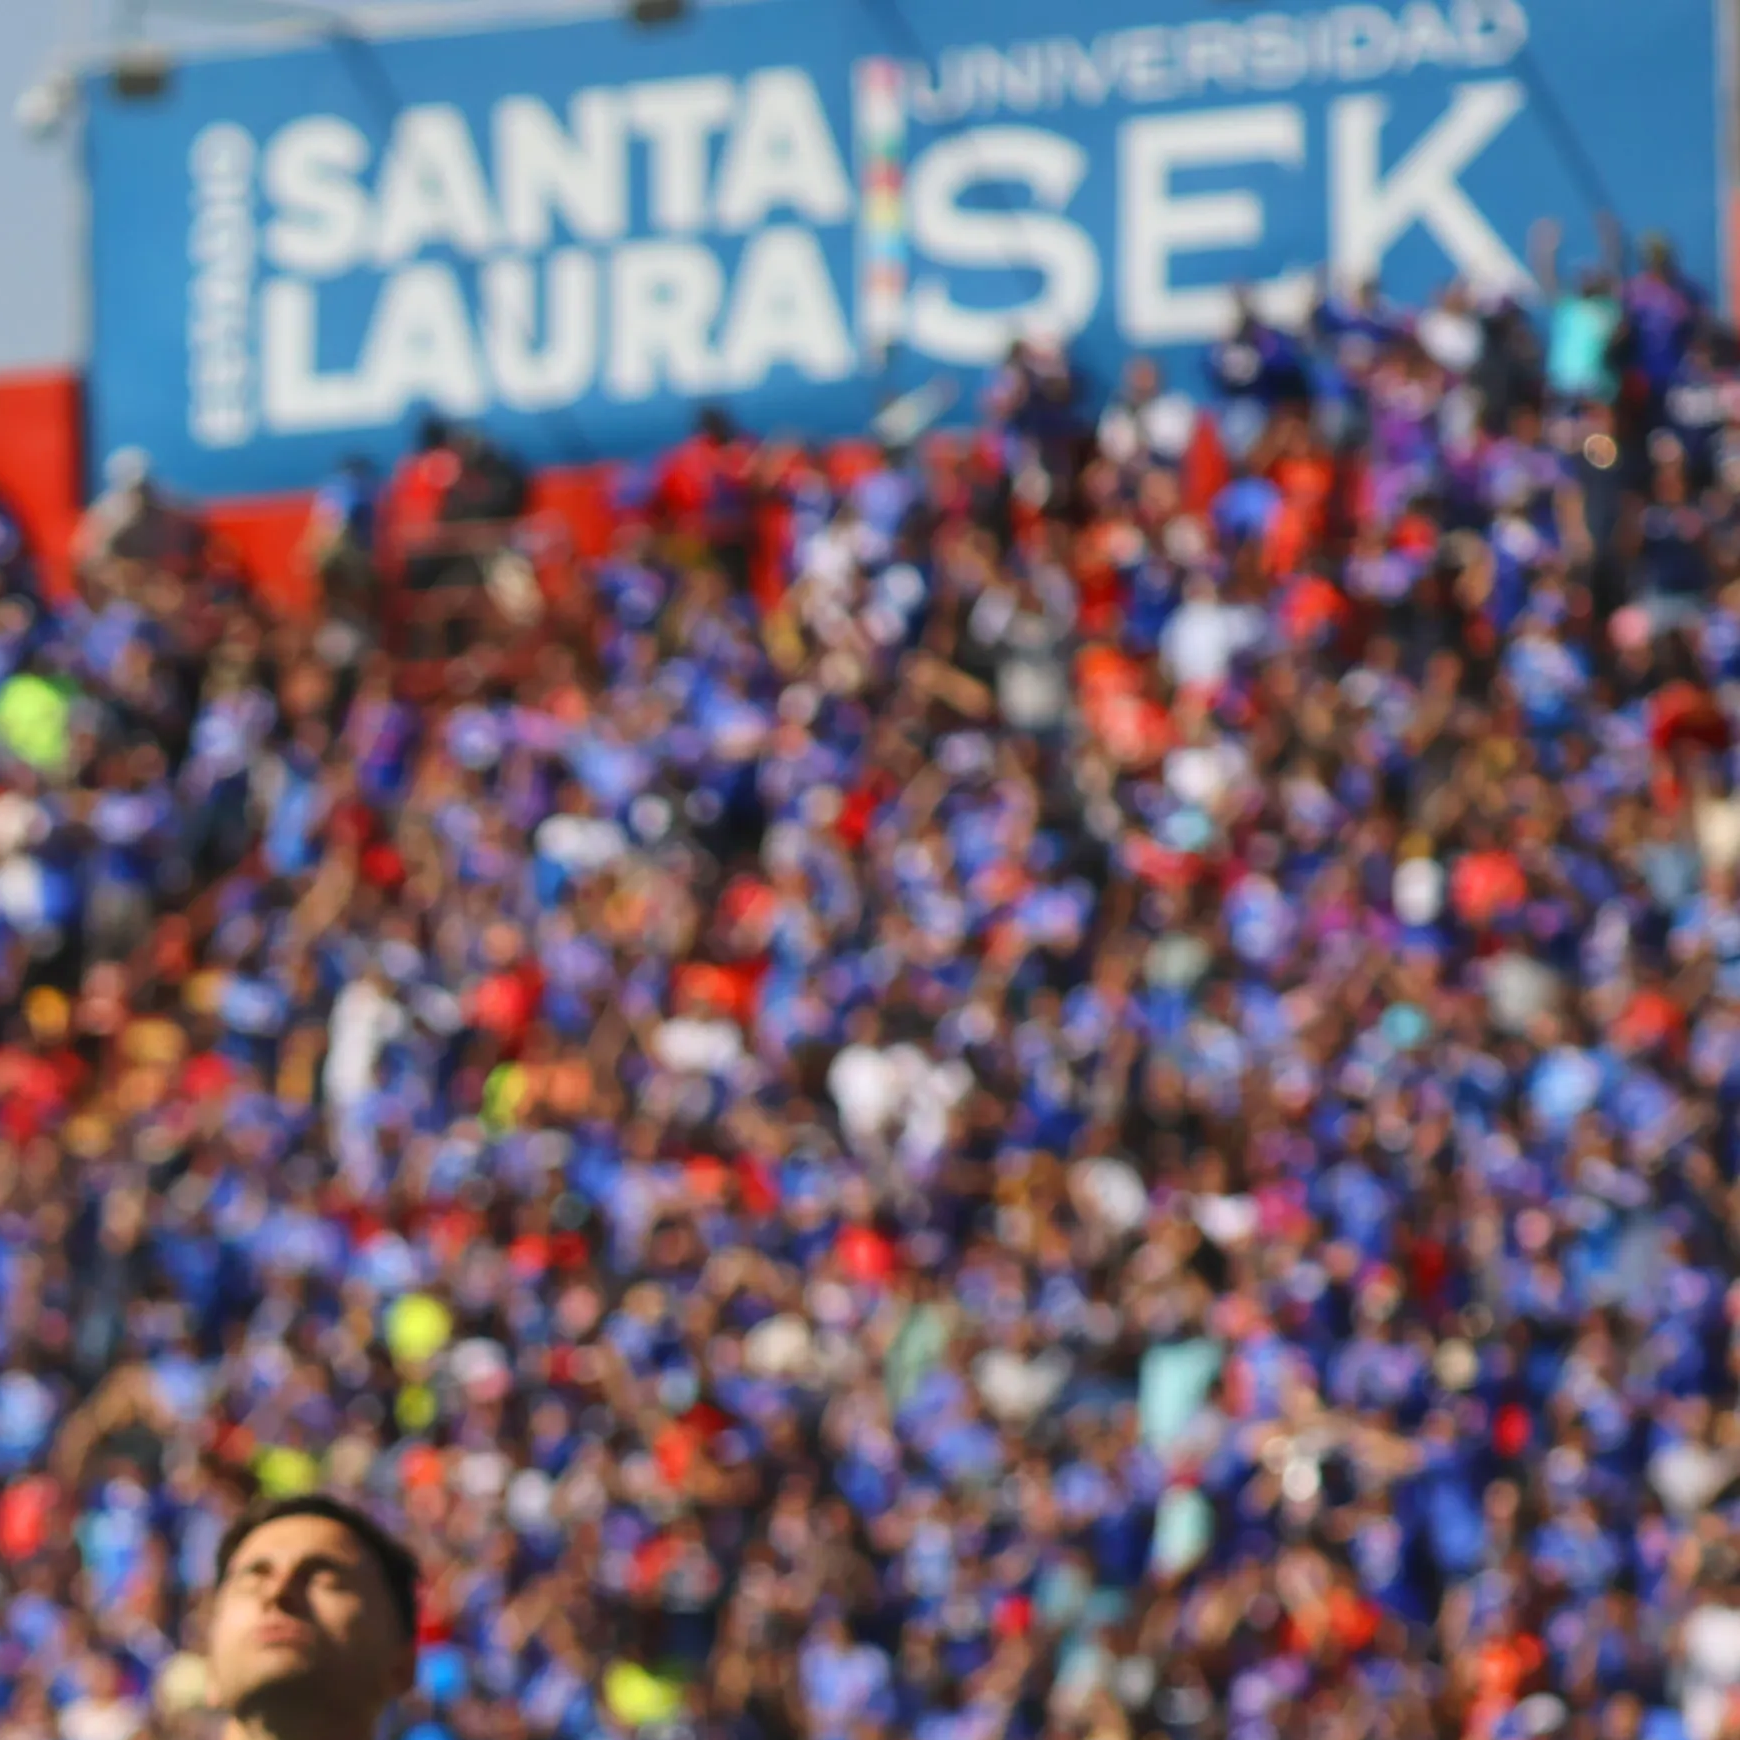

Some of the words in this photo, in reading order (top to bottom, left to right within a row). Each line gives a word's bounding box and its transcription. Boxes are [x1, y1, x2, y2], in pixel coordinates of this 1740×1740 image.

[909, 2, 1527, 122] UNIVERSIDAD
[263, 69, 851, 272] SANTA
[911, 80, 1536, 364] SEK
[263, 228, 855, 432] LAURA
